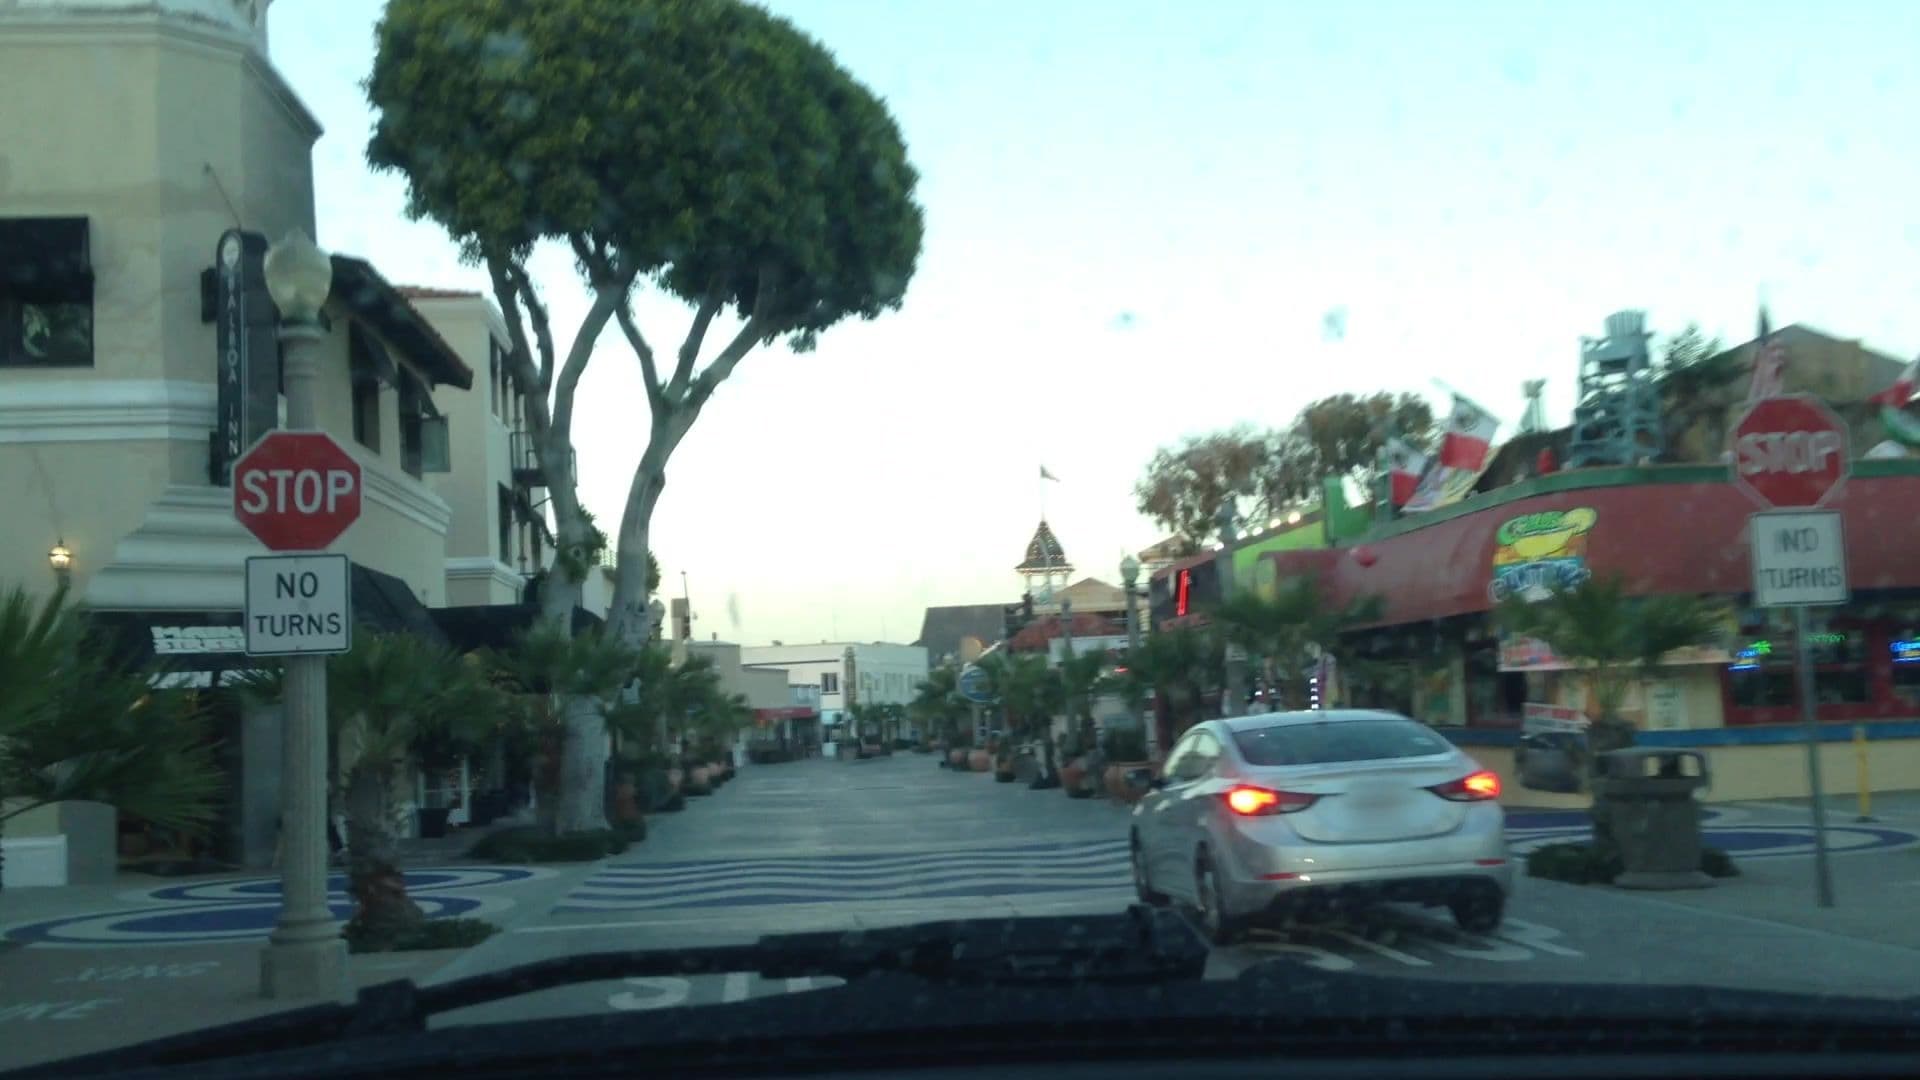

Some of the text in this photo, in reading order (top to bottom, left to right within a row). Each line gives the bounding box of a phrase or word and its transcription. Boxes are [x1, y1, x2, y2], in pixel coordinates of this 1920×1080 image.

[228, 402, 239, 455] INN
[1737, 430, 1841, 475] STOP
[241, 469, 354, 514] STOP
[1773, 527, 1819, 552] NO
[275, 571, 318, 599] NO
[1760, 567, 1841, 588] TURNS
[254, 612, 342, 637] TURNS
